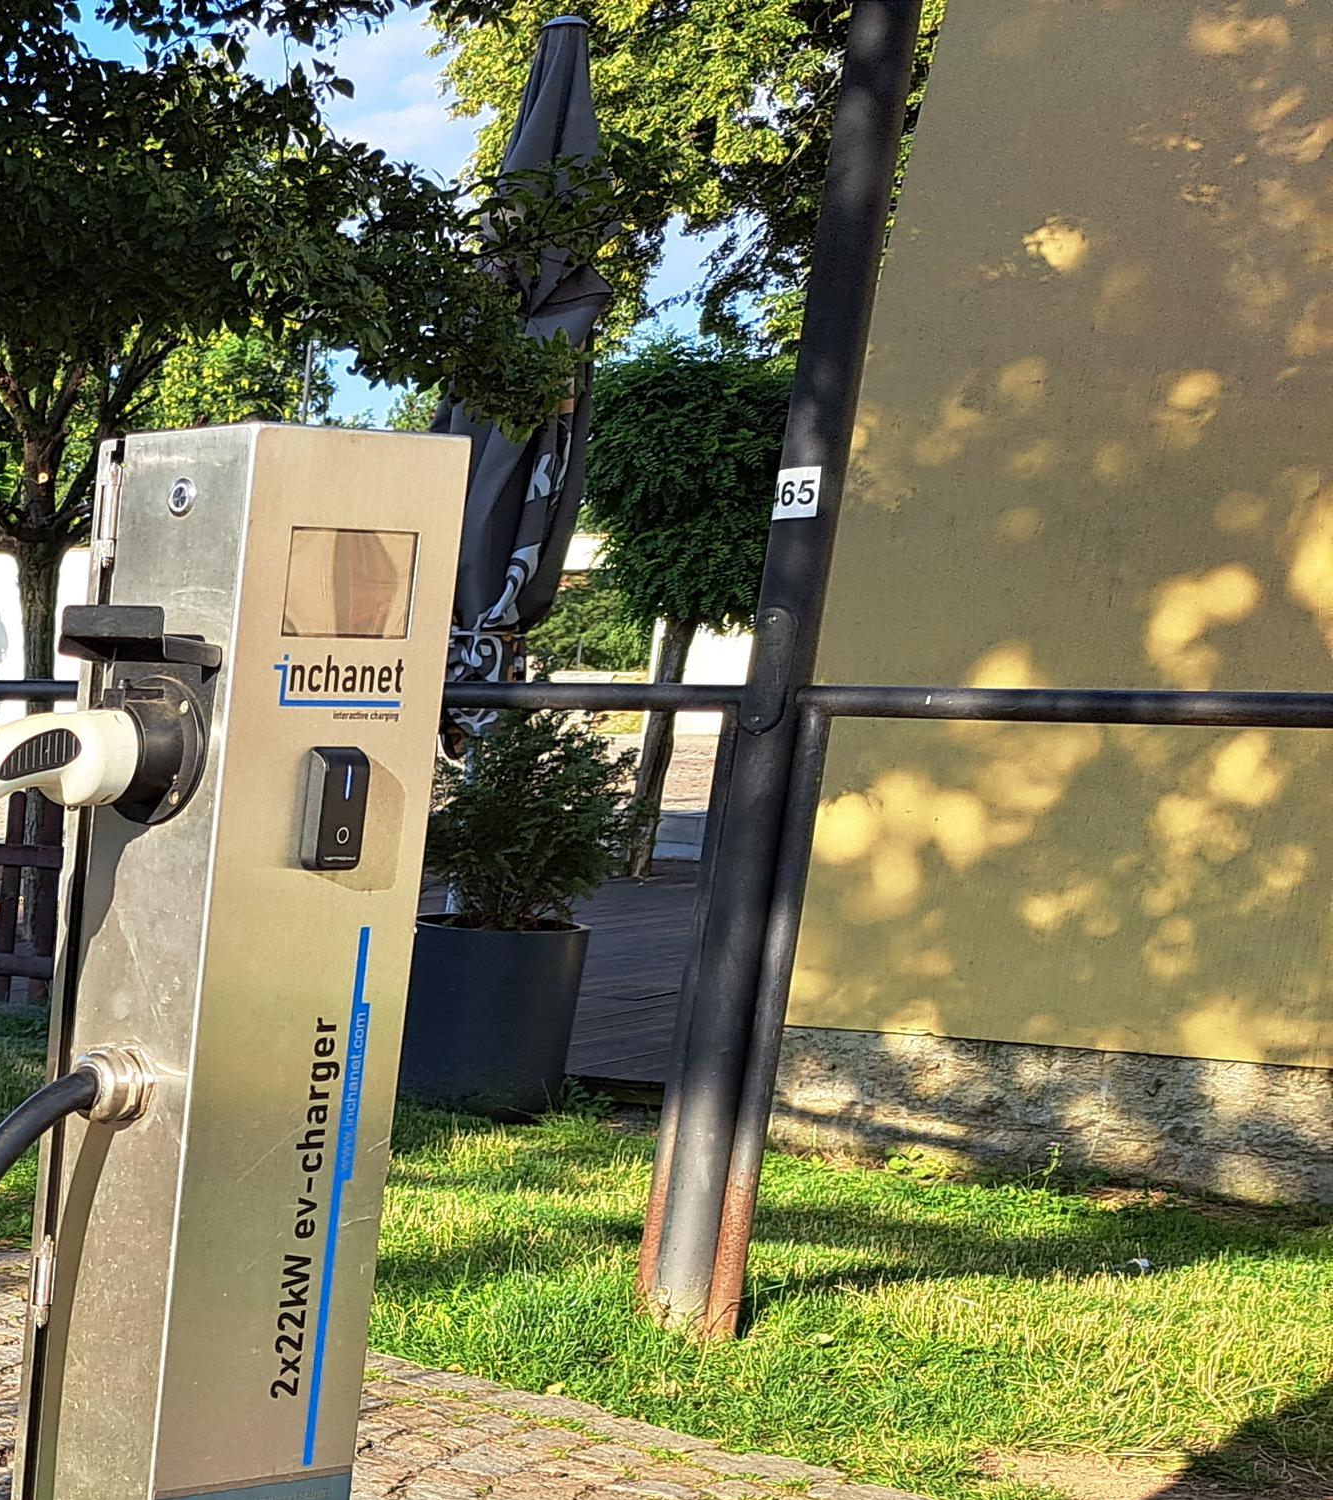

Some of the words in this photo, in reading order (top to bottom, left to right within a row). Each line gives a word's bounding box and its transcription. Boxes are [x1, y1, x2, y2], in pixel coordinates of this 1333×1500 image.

[274, 654, 404, 706] inchanet
[370, 711, 399, 722] charging
[341, 1012, 367, 1173] www.inchanet.com
[271, 1254, 312, 1400] 2x22kW
[294, 1016, 340, 1240] ev-charger
